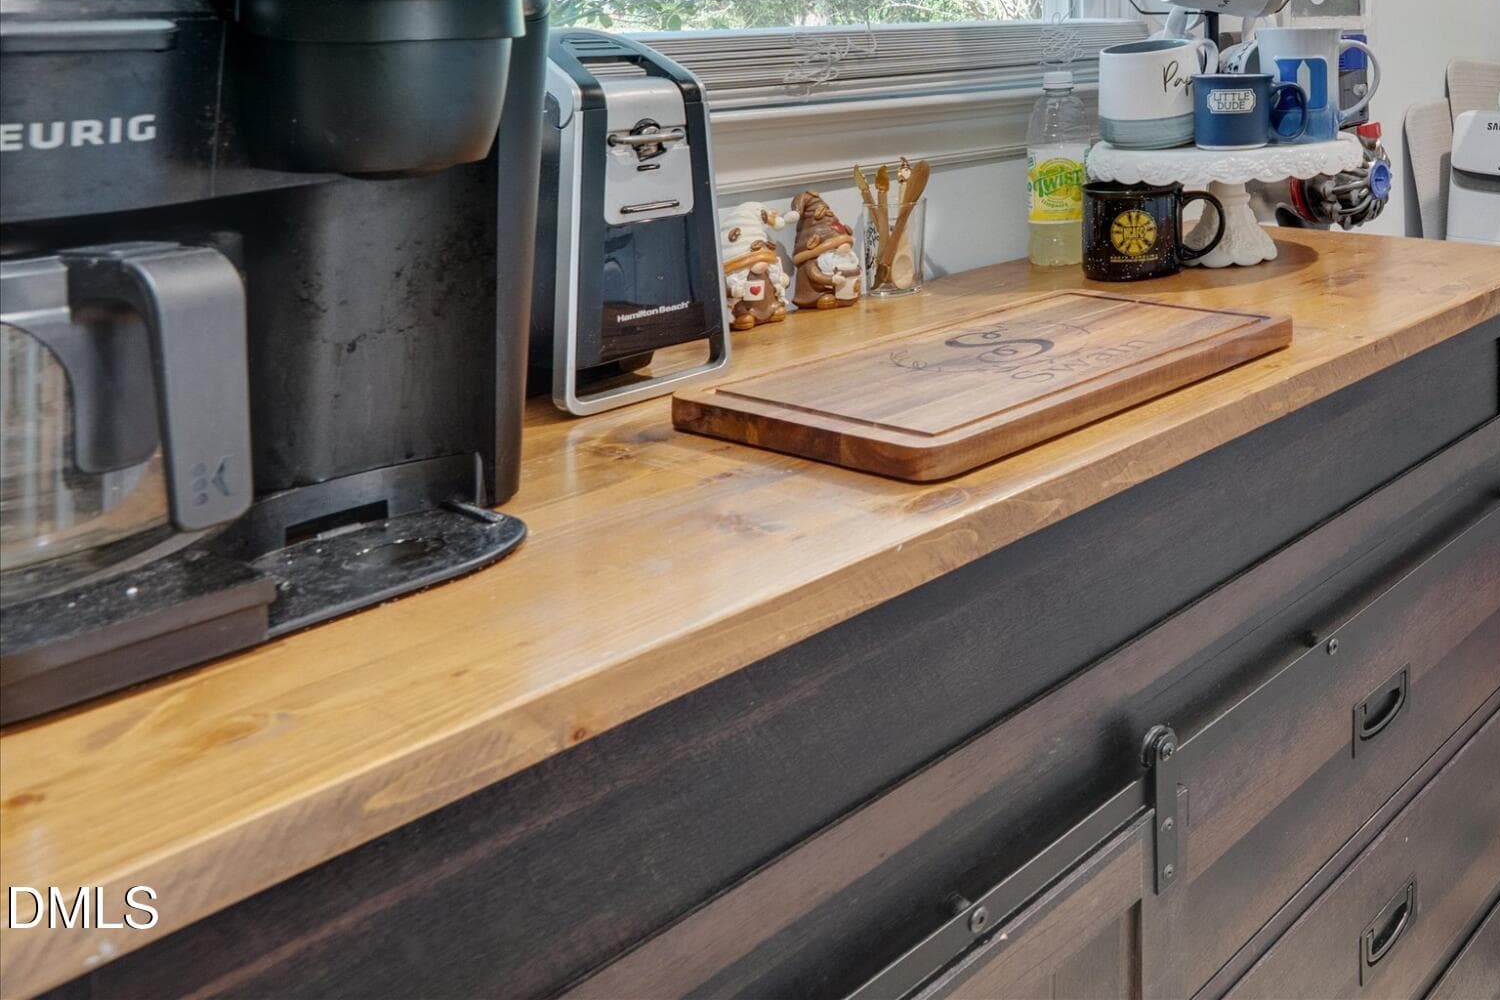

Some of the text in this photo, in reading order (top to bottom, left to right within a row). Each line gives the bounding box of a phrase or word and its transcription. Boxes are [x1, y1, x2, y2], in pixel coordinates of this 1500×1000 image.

[1163, 60, 1194, 97] Pap
[1213, 91, 1251, 102] LITTLE
[1217, 101, 1246, 110] DUDE
[0, 114, 157, 151] EURIG
[616, 302, 689, 322] Hamilton Beach
